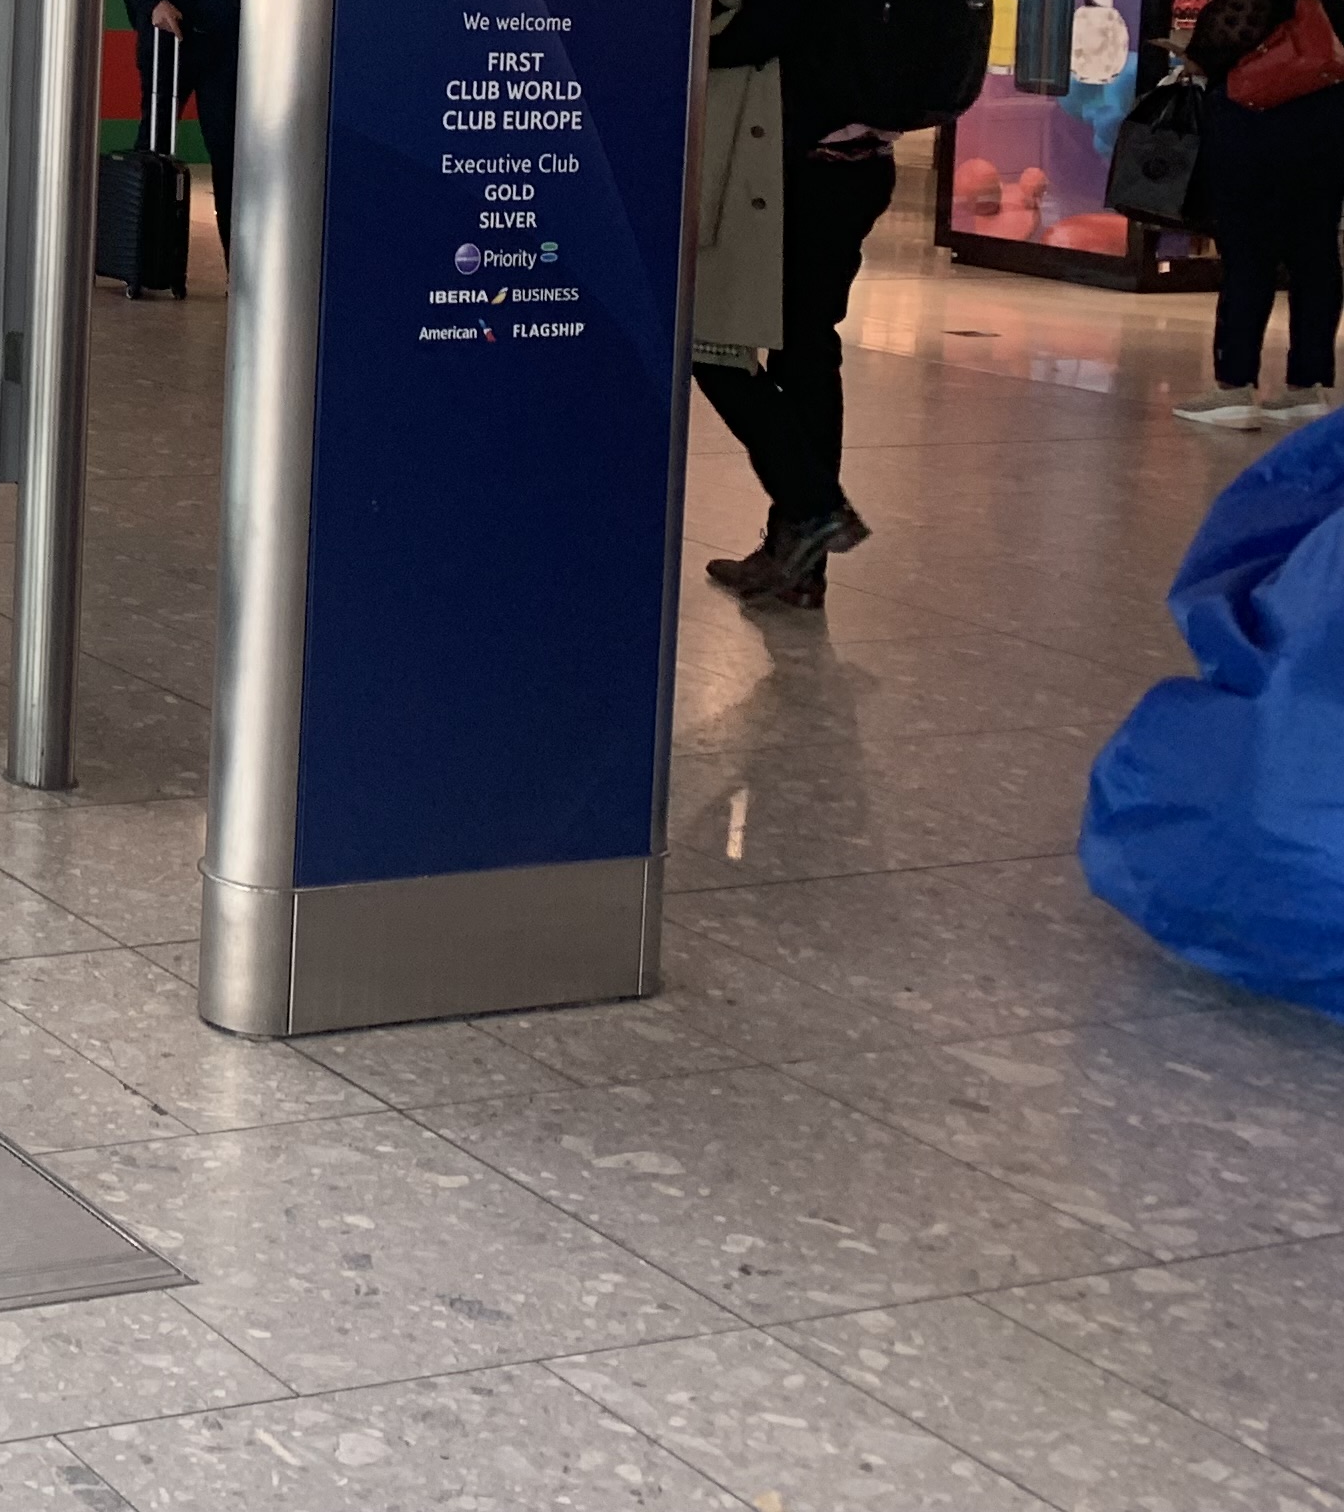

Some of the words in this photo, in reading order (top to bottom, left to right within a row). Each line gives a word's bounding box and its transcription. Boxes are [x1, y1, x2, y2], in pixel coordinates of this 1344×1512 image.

[463, 11, 490, 31] We
[496, 12, 572, 32] welcome
[487, 51, 545, 73] FIRST
[446, 80, 500, 101] CLUB
[506, 80, 582, 101] WORLD
[442, 110, 497, 131] CLUB
[503, 110, 583, 131] EUROPE
[441, 153, 532, 174] Executive
[538, 153, 580, 174] Club
[484, 184, 535, 202] GOLD
[479, 211, 538, 229] SILVER
[484, 248, 538, 271] Priority
[429, 289, 489, 305] IBERIA
[512, 287, 580, 303] BUSINESS
[419, 325, 478, 341] American
[512, 321, 585, 338] FLAGSHIP
